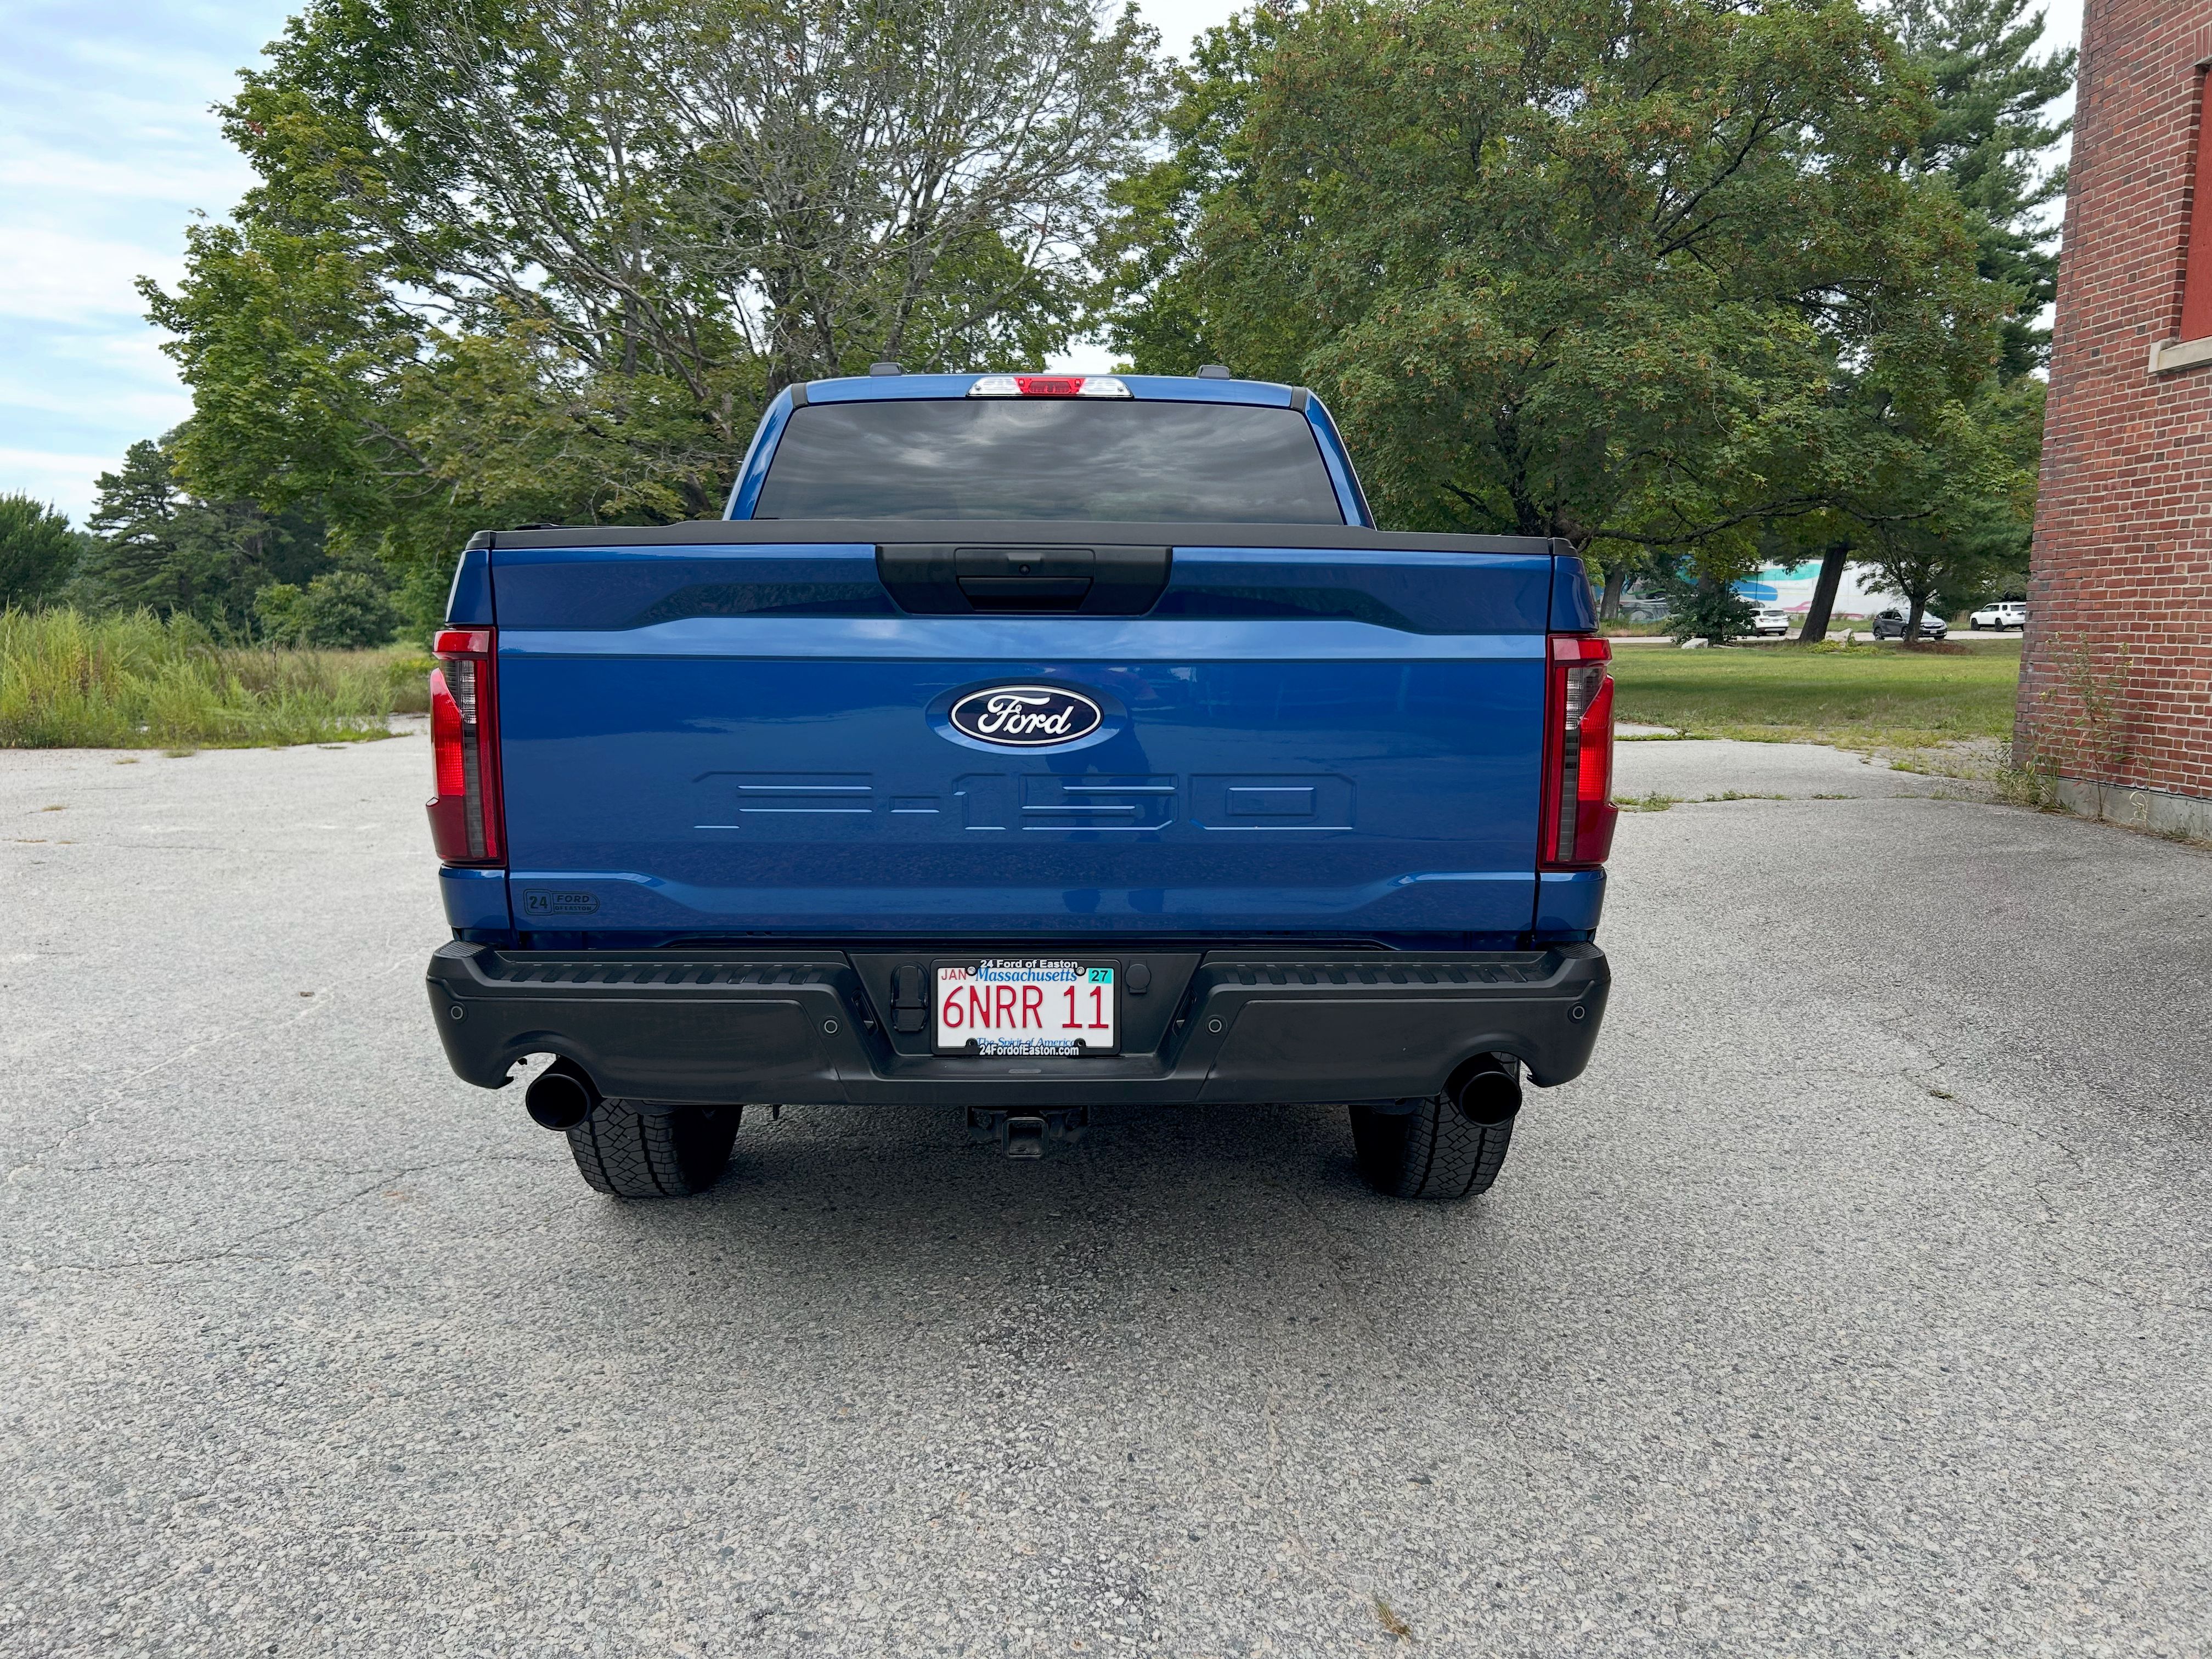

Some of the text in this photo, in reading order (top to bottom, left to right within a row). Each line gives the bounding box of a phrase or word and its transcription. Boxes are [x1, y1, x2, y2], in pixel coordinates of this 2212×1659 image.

[978, 694, 1074, 735] Ford
[692, 770, 1357, 832] F-150
[529, 895, 548, 909] 24
[557, 895, 590, 903] FORD
[980, 959, 1079, 968] 24 Ford of Easton
[941, 969, 967, 980] JAN
[975, 967, 1077, 982] Massachusetts
[1091, 969, 1108, 982] 27
[943, 985, 1043, 1028] 6NRR
[1062, 985, 1109, 1029] 11
[998, 1037, 1023, 1047] Spirit
[1025, 1037, 1035, 1047] of
[979, 1043, 1079, 1056] 24FordofEaston.com
